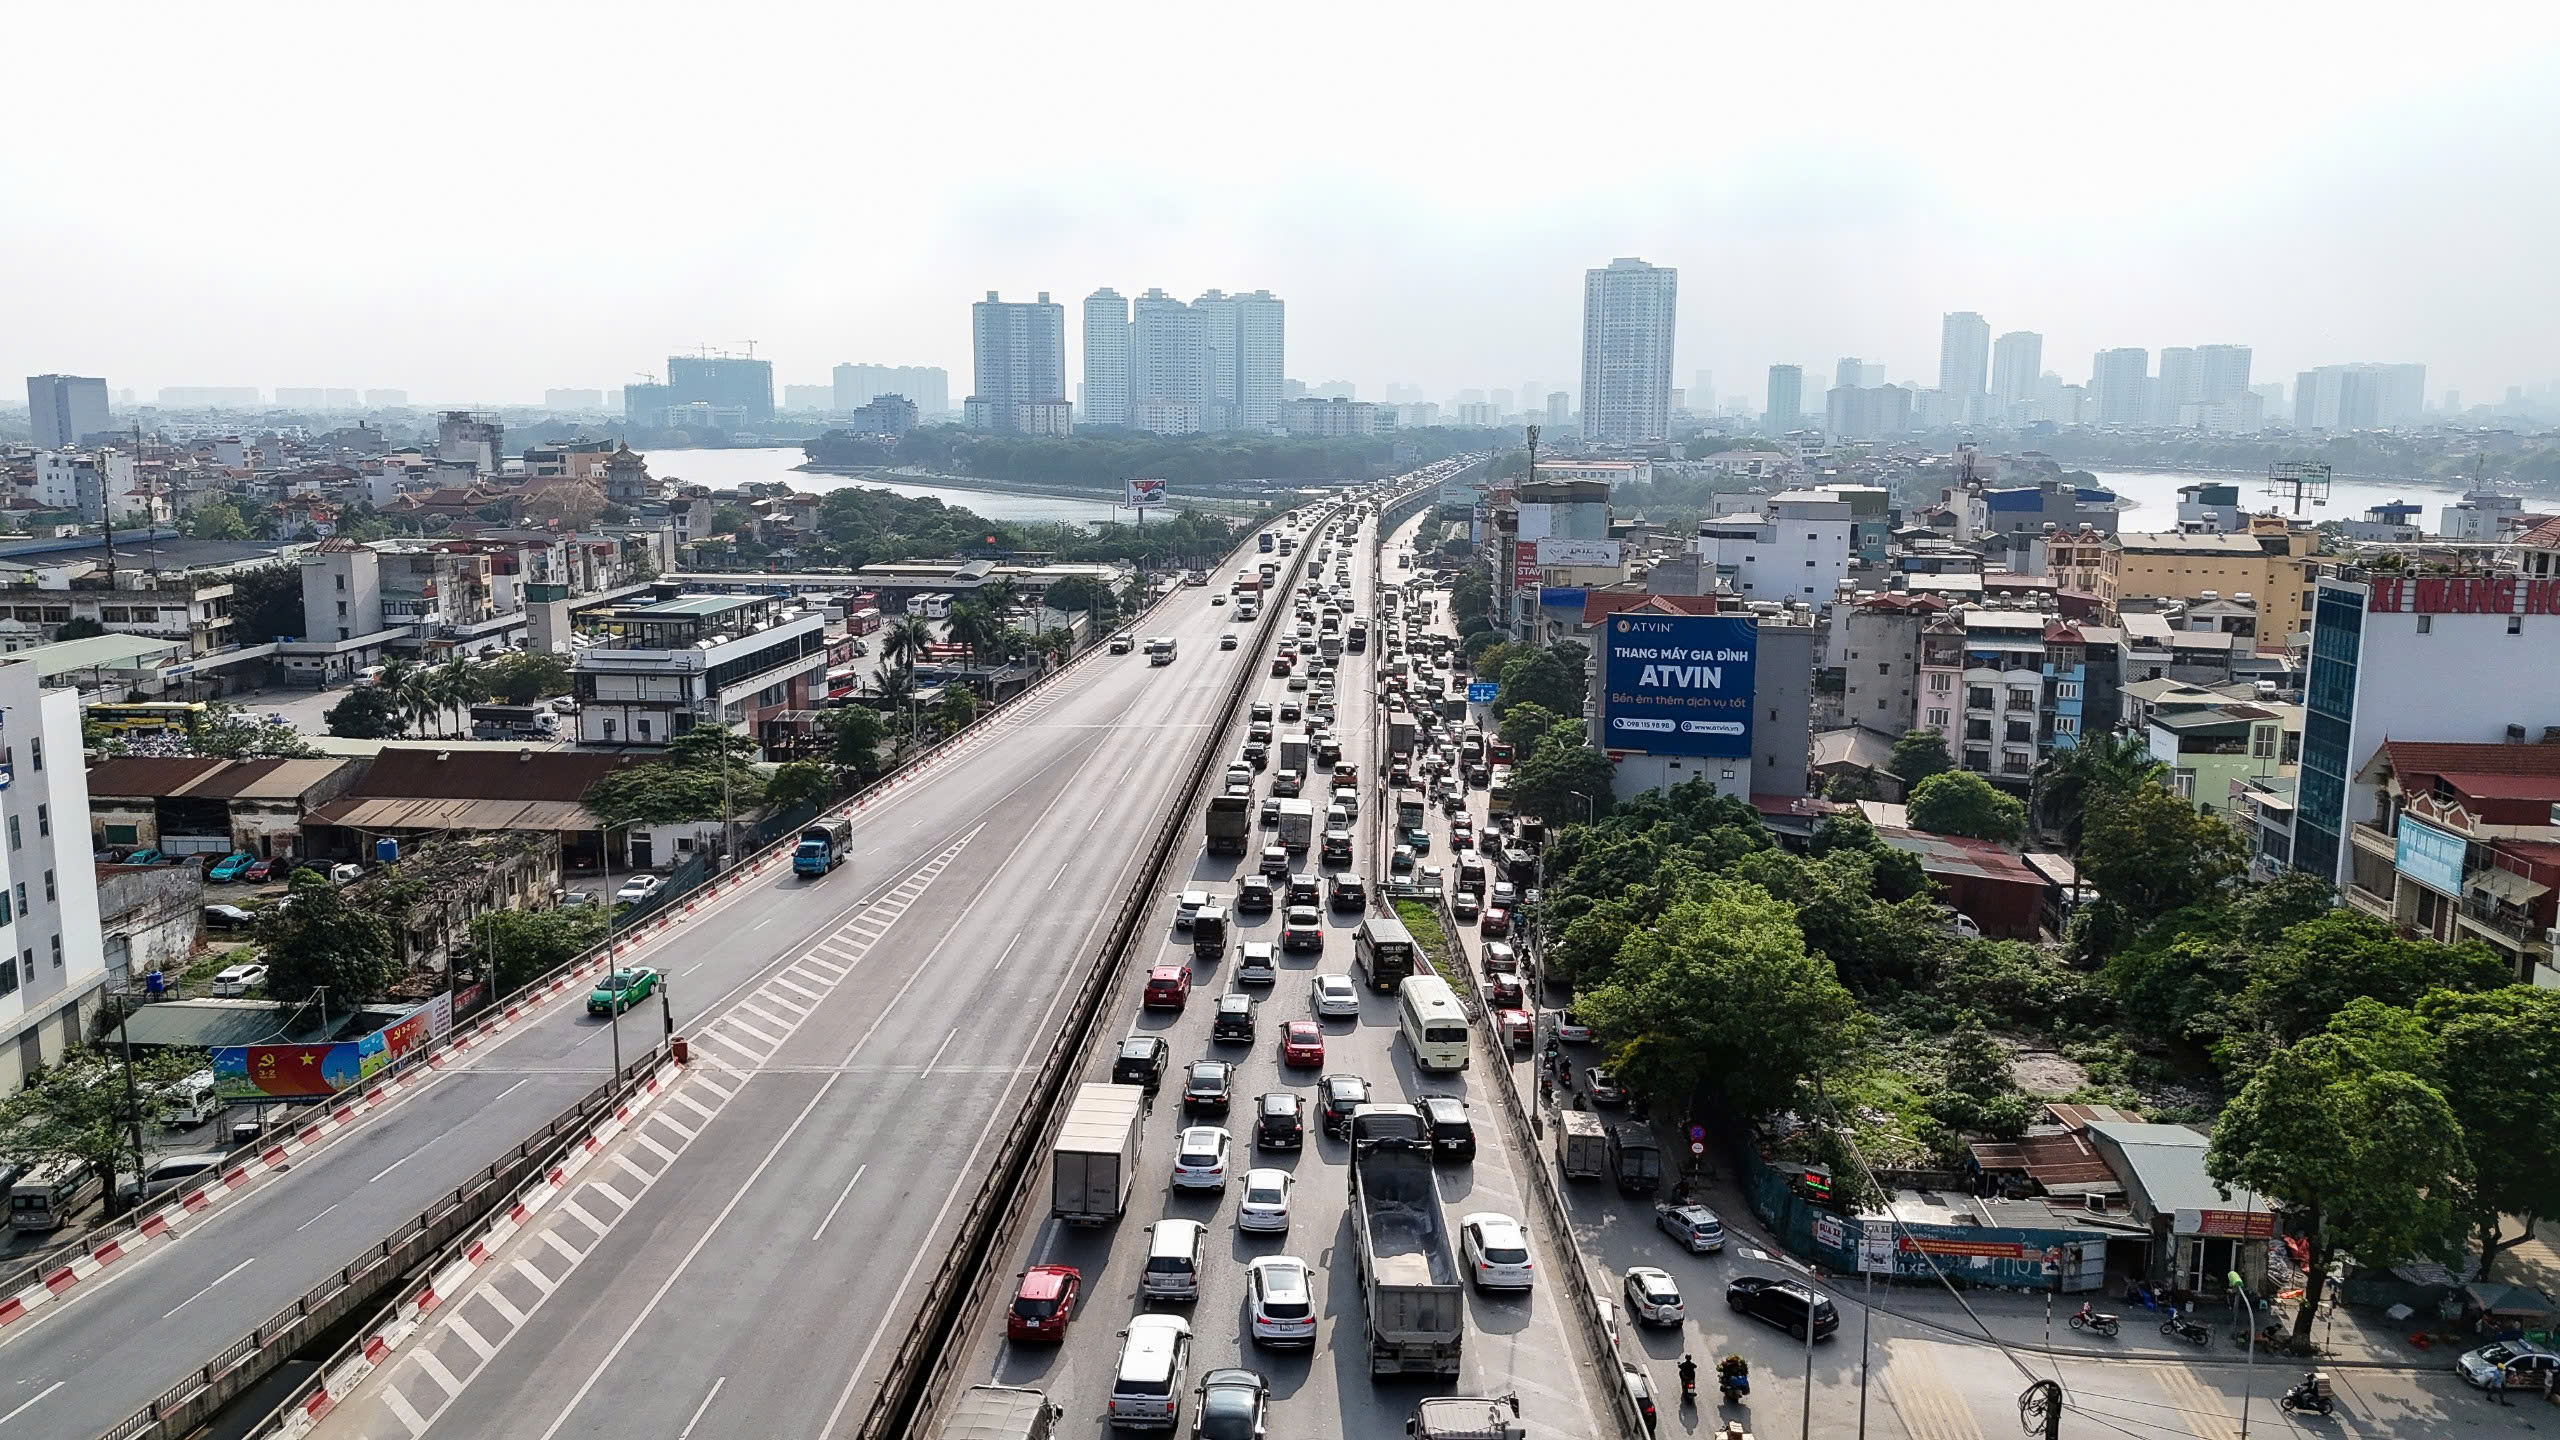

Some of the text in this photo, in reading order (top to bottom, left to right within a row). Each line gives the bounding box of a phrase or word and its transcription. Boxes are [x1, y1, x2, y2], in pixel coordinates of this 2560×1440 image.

[1614, 646, 1749, 662] THANG MÁY GIA ĐÌNH
[1638, 664, 1722, 689] ATVIN
[1656, 695, 1684, 705] thêm
[1687, 697, 1710, 708] dịch
[1713, 699, 1727, 709] vụ
[1729, 697, 1746, 708] tốt
[1694, 724, 1739, 732] www.atvin.vn
